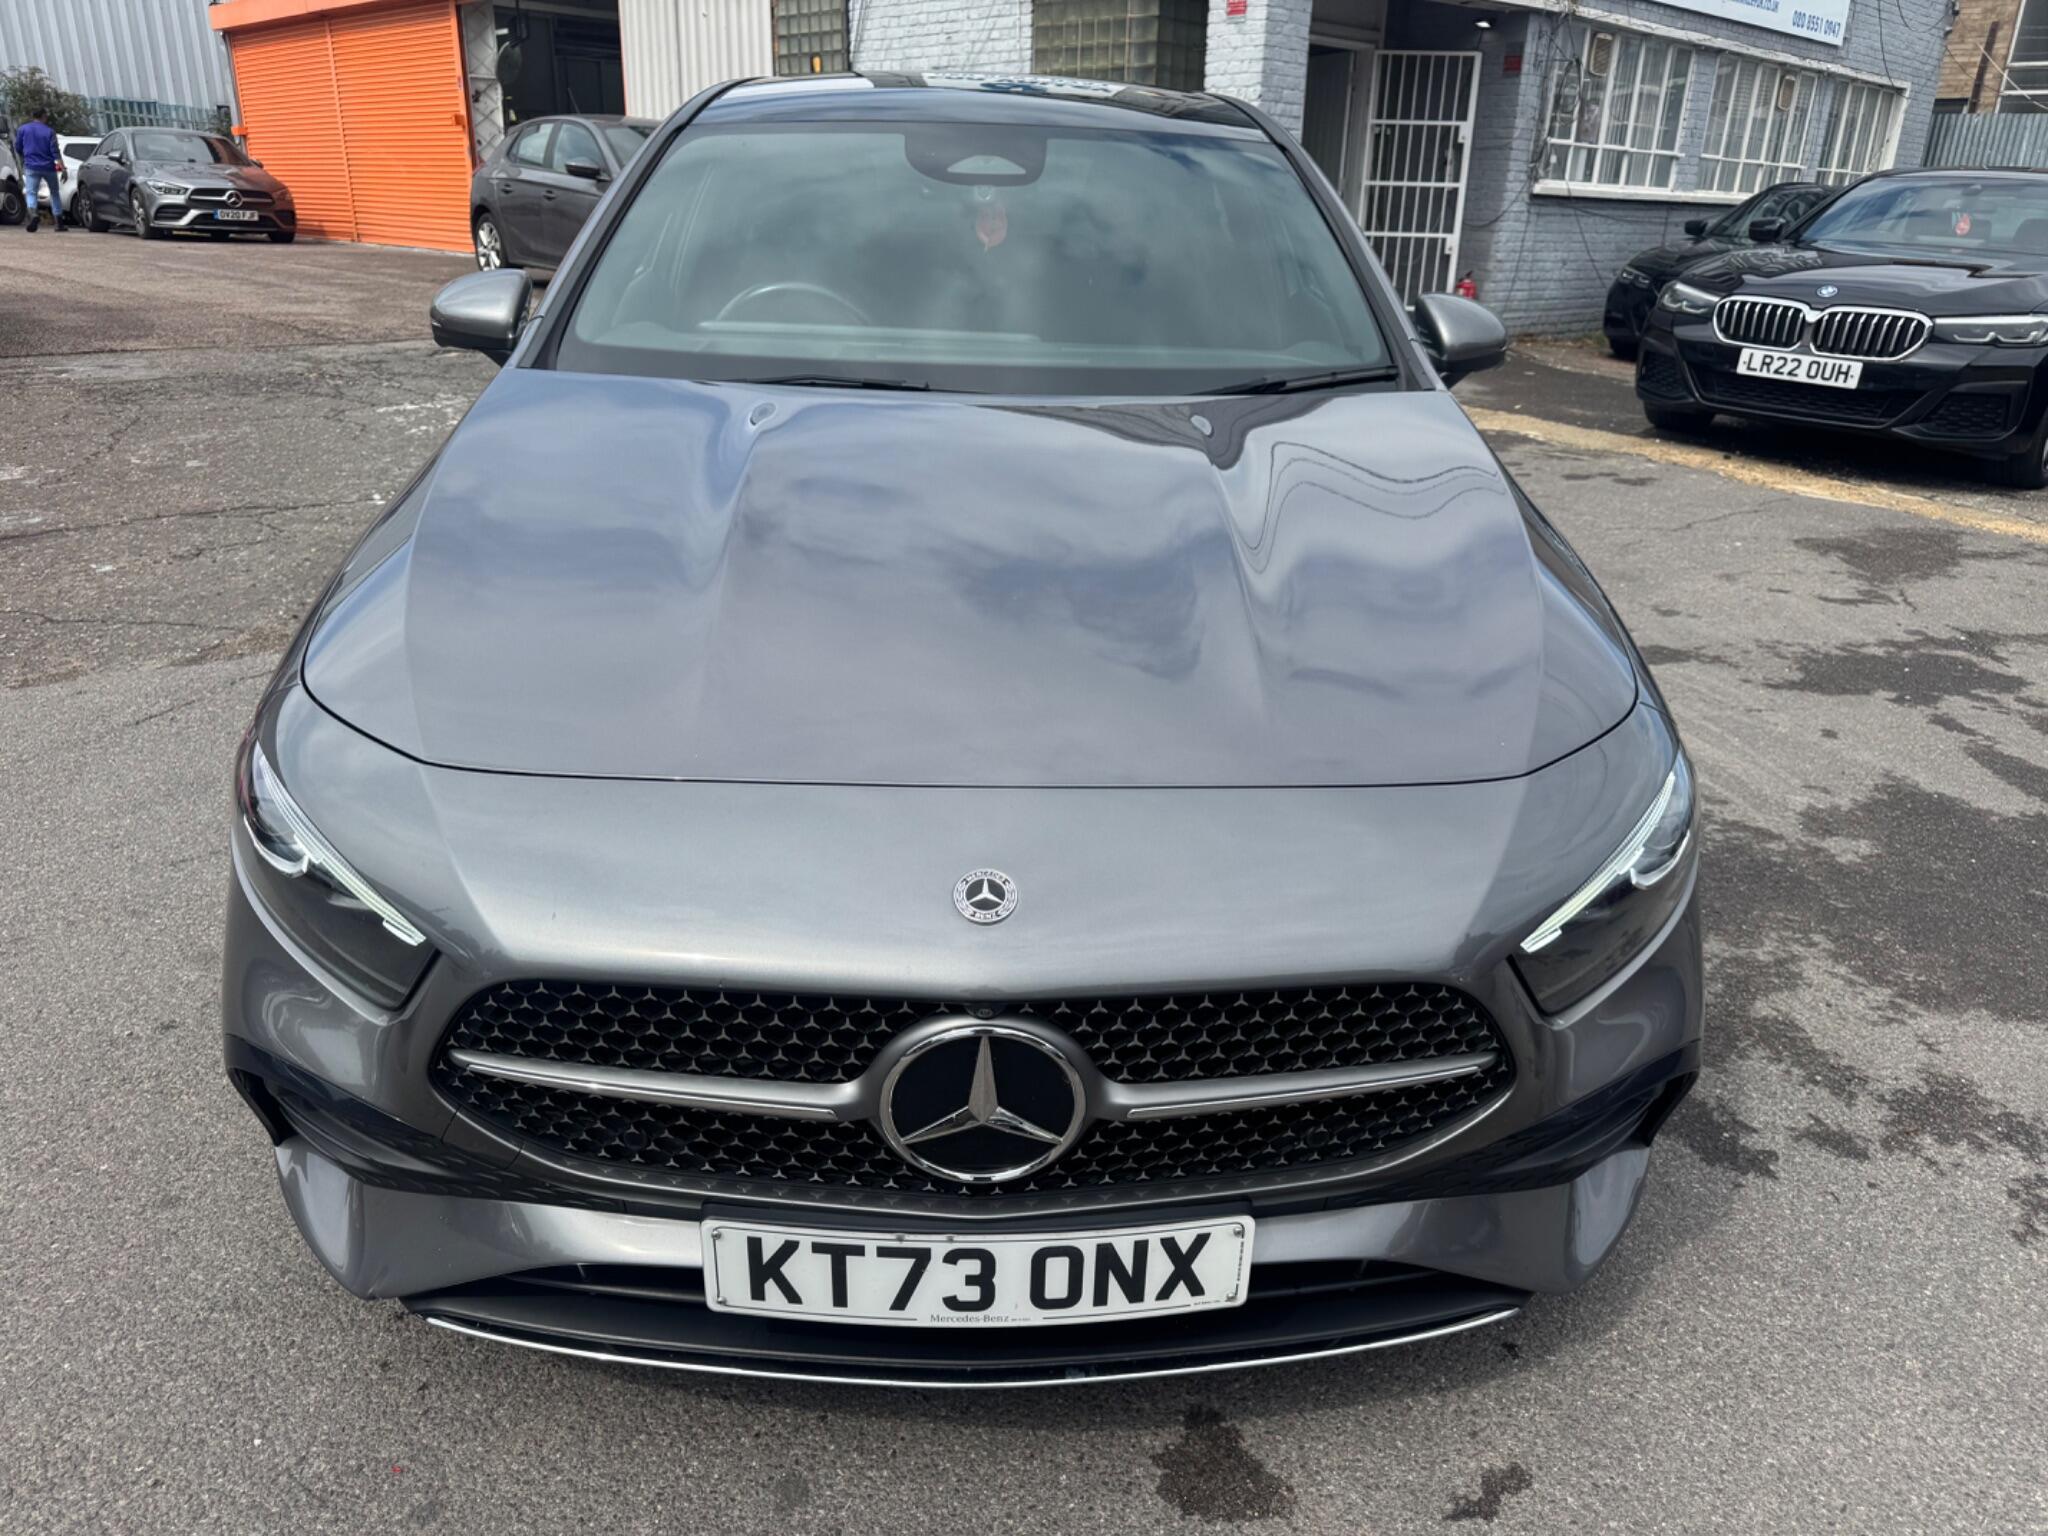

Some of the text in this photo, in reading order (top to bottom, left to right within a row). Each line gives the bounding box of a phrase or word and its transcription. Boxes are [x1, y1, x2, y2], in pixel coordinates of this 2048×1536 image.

[1746, 352, 1851, 384] LR22 OUH
[747, 1236, 996, 1312] KT73
[1030, 1232, 1211, 1311] ONX
[930, 1314, 1009, 1323] Mercedes-Benz
